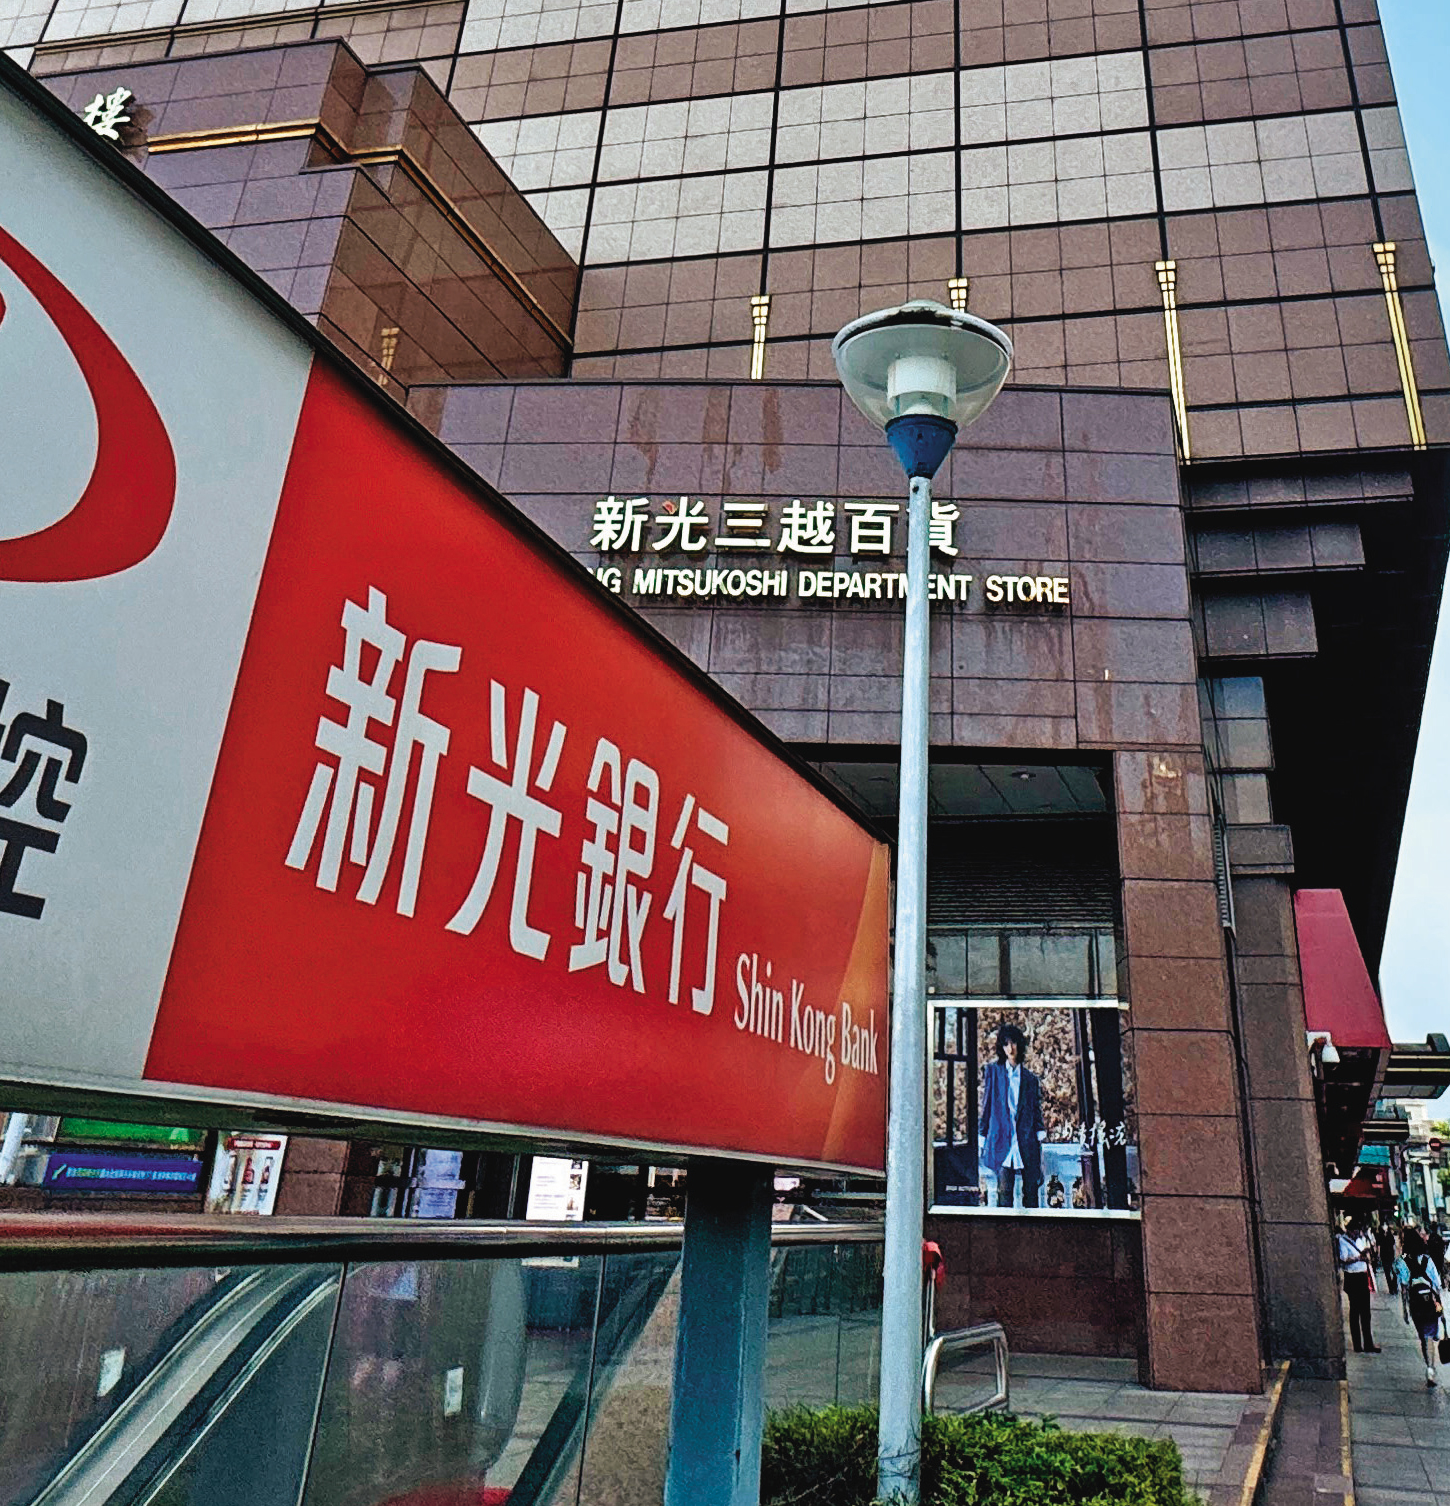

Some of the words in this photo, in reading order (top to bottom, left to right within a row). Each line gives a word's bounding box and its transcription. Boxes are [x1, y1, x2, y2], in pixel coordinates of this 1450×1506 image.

[590, 495, 961, 558] 新光三越百貨
[633, 566, 788, 597] MITSUKOSHI
[985, 574, 1070, 604] STORE
[284, 584, 730, 1016] 新光銀行
[734, 952, 785, 1039] Shin
[789, 978, 838, 1085] Kong
[840, 1004, 879, 1076] Bank
